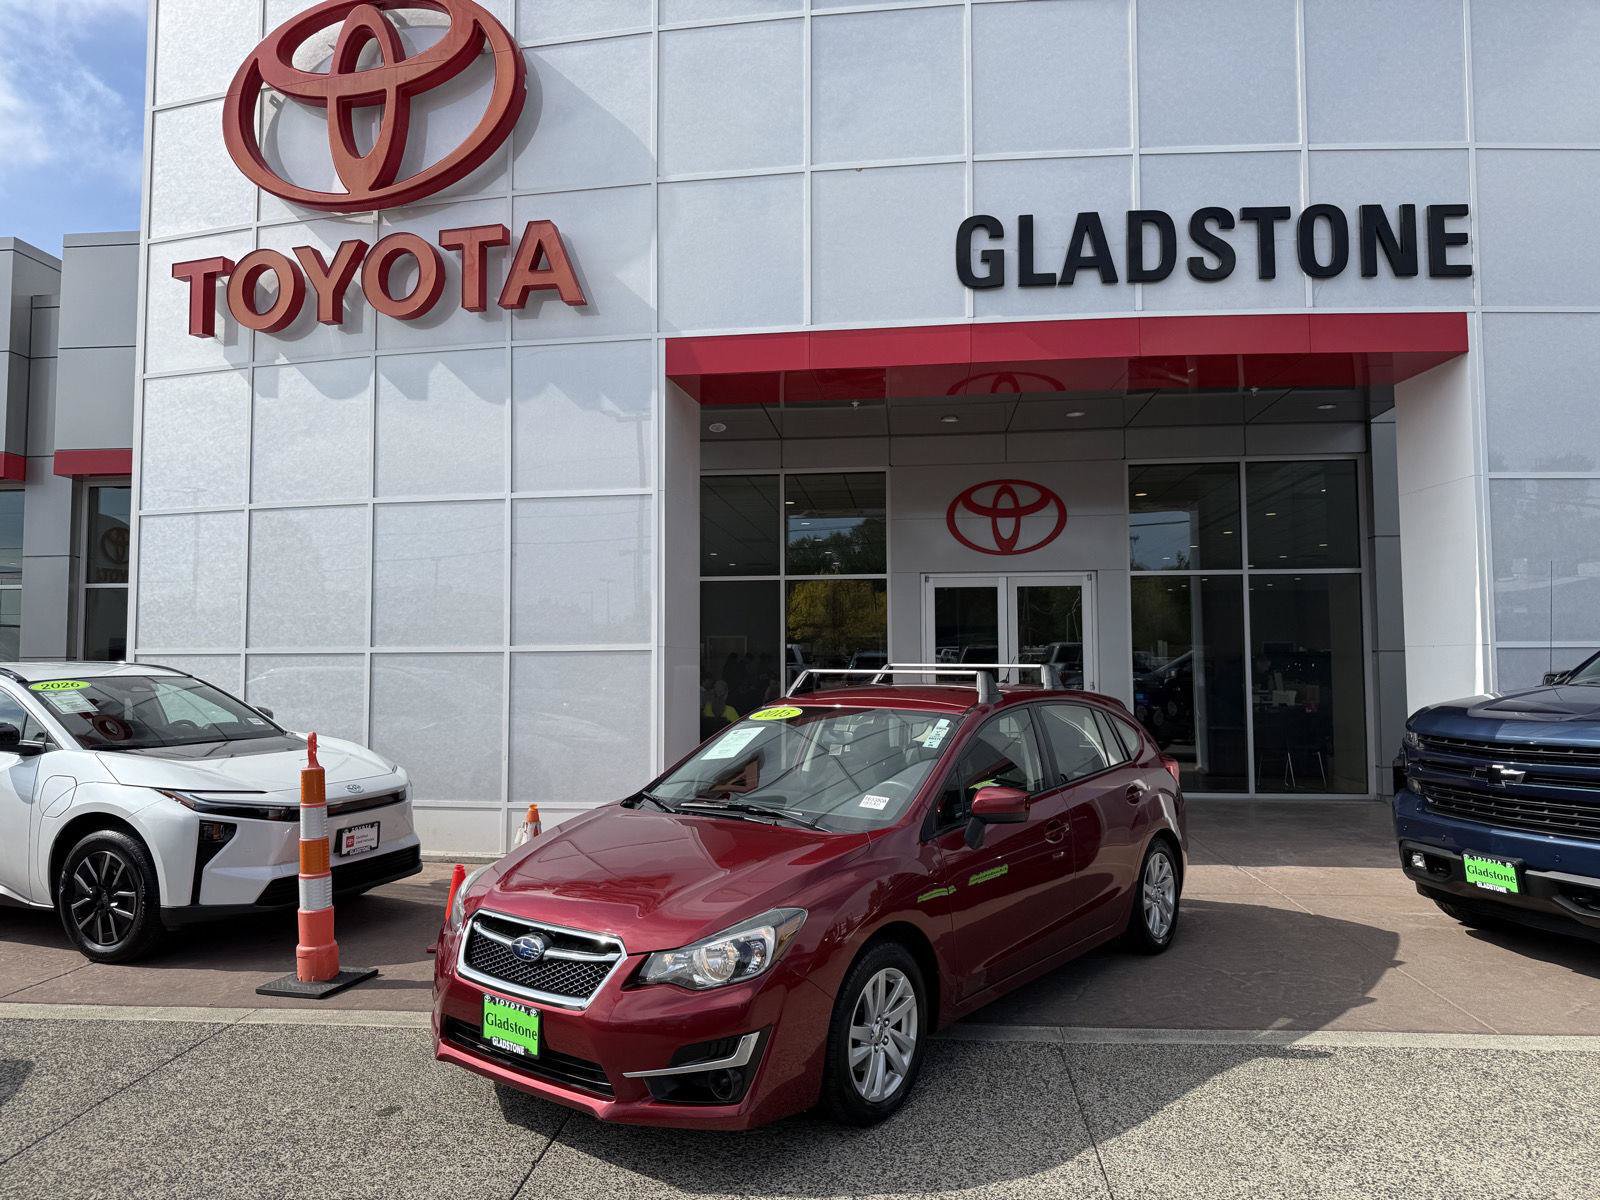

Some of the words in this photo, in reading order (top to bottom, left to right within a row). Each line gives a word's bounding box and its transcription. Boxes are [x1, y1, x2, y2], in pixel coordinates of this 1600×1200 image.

[955, 204, 1473, 289] GLADSTONE
[172, 219, 587, 338] TOYOTA
[41, 682, 80, 690] 2026
[1466, 864, 1516, 884] Gladstone
[495, 997, 526, 1014] TOYOTA
[485, 1012, 538, 1041] Gladstone
[492, 1036, 525, 1056] GLADSTONE
